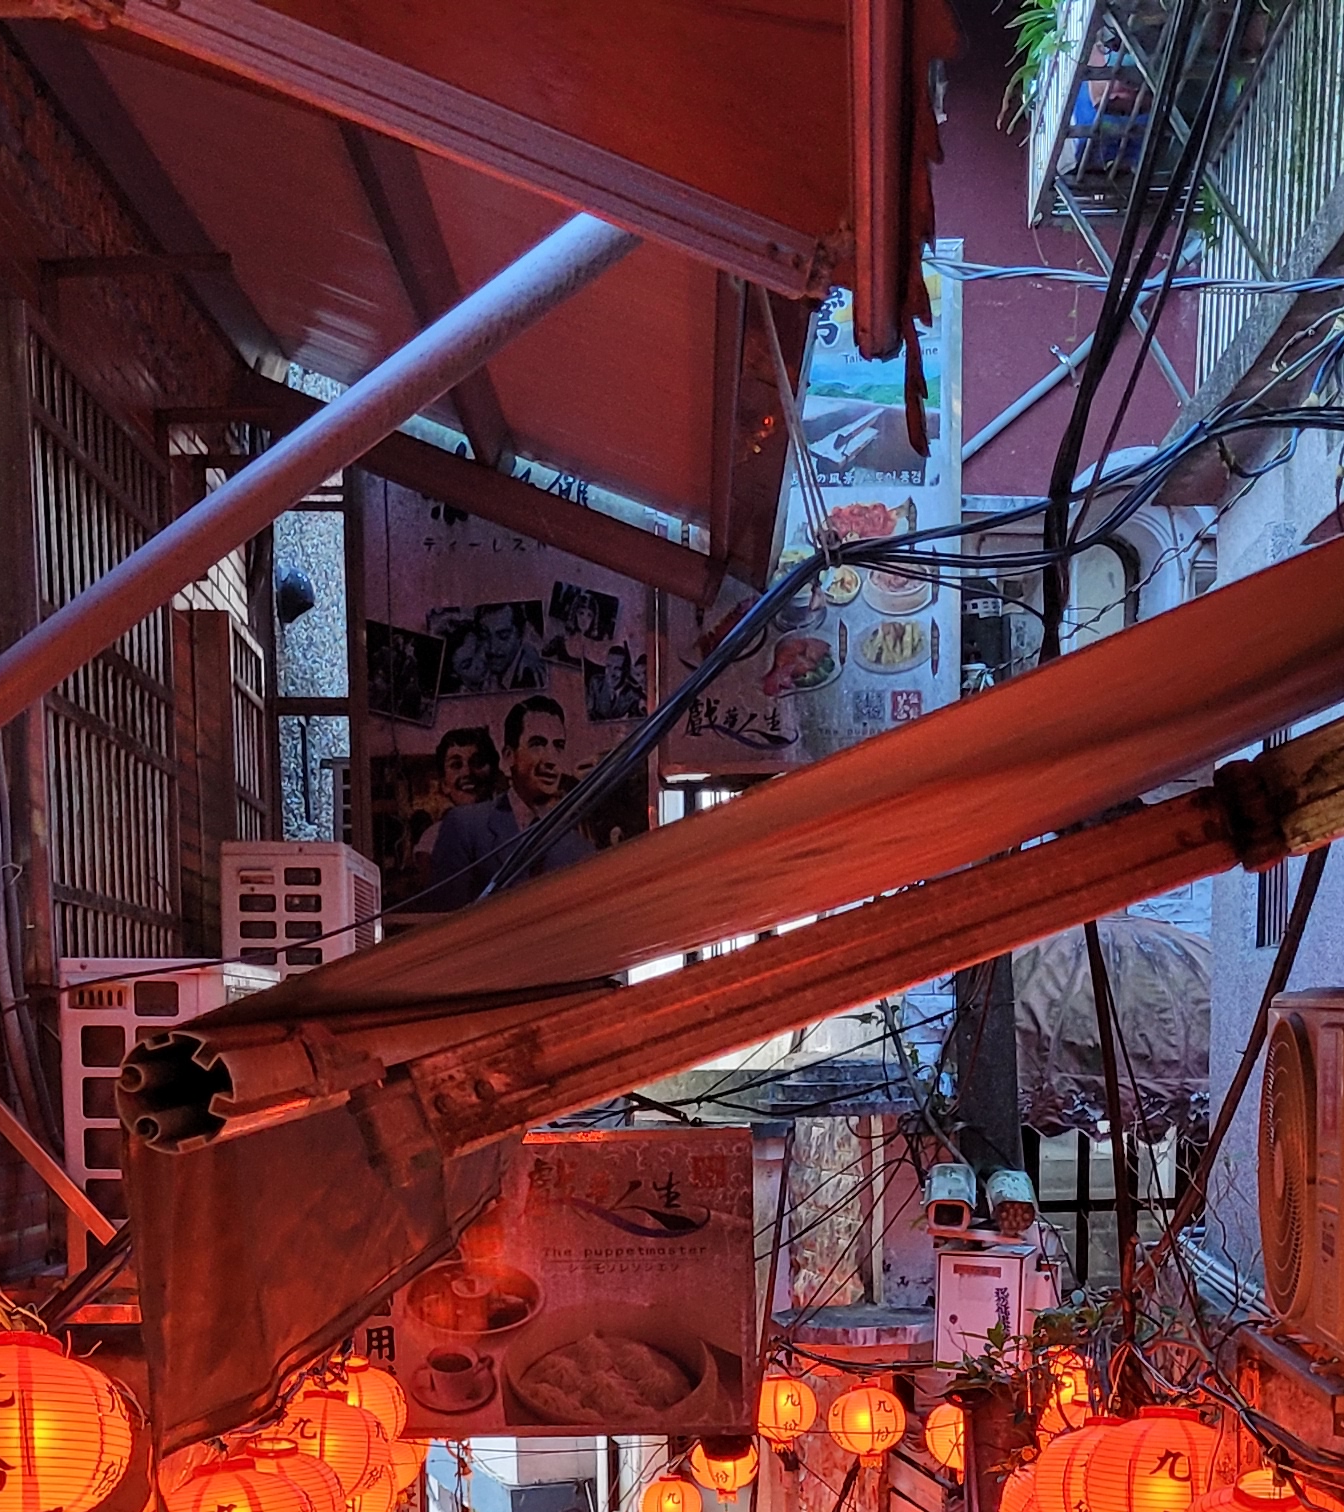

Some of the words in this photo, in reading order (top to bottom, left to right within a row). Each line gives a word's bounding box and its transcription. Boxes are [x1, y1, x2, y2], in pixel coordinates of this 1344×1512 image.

[543, 1246, 575, 1258] The
[583, 1246, 707, 1260] puppetmaster
[874, 1400, 893, 1442] 九份
